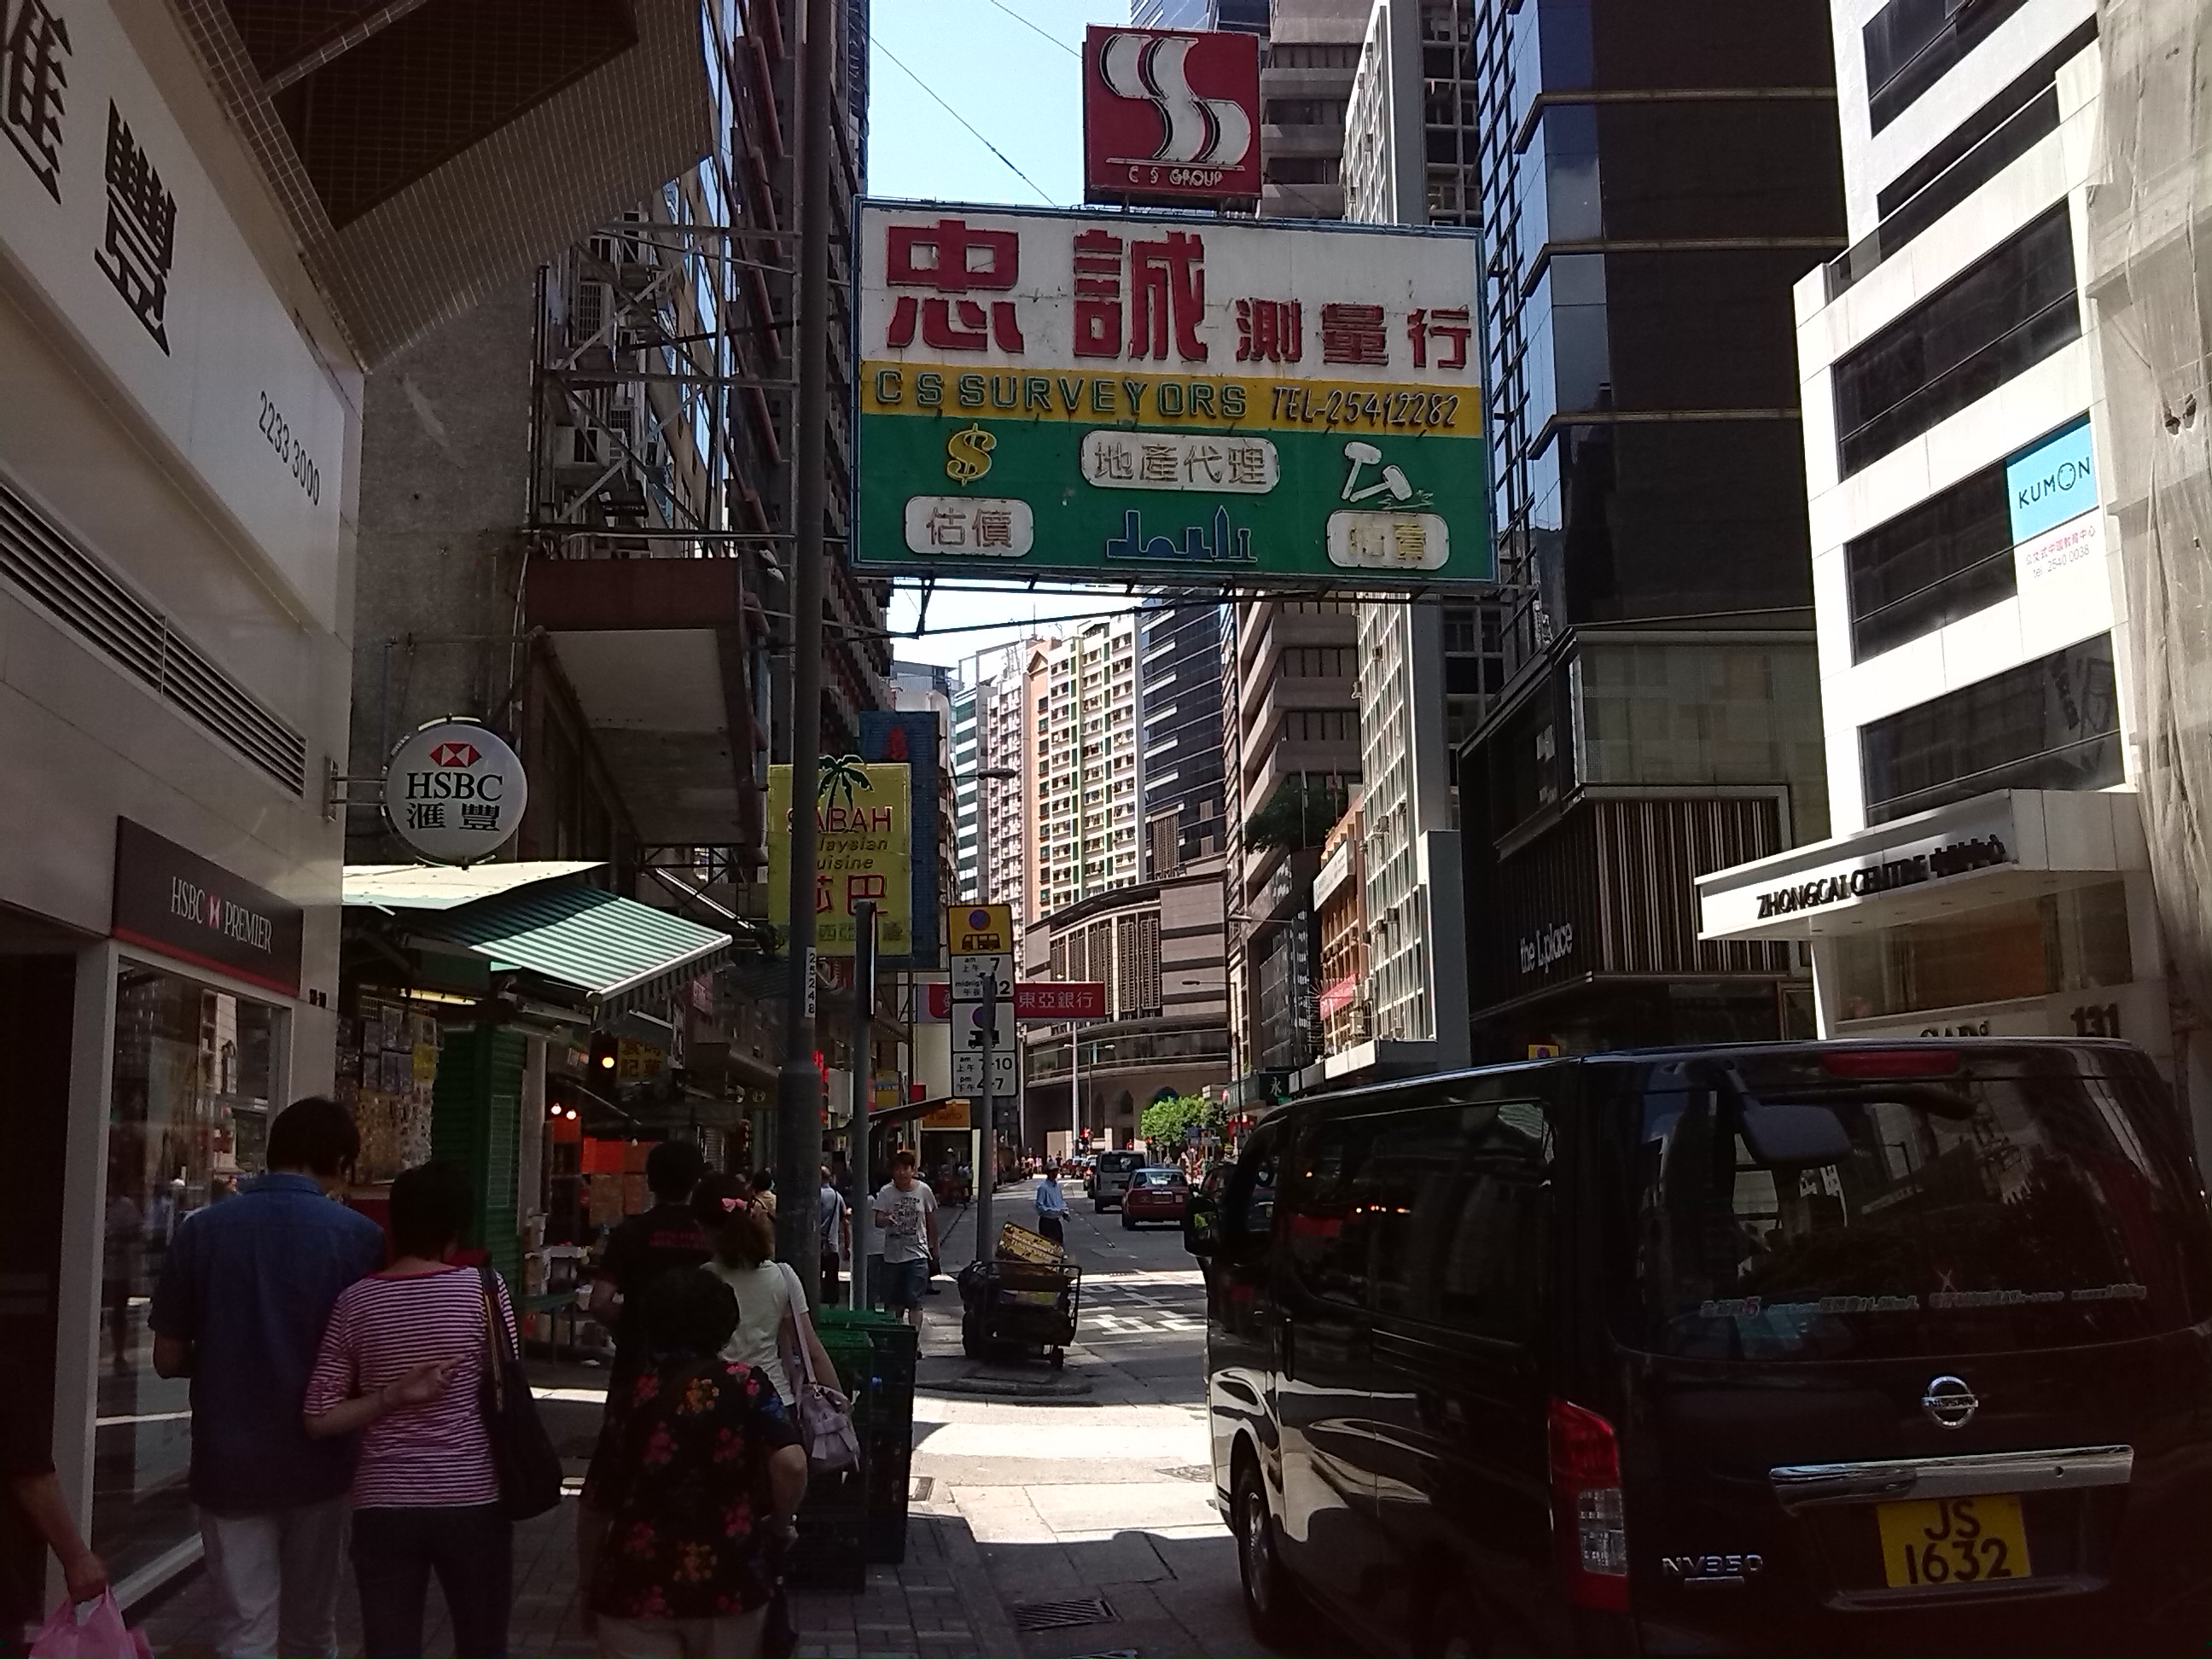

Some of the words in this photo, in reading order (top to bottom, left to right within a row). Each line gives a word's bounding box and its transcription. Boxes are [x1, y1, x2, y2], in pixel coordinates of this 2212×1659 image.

[1168, 168, 1224, 187] GROUP
[886, 219, 1472, 369] 忠誠測量行
[959, 373, 1248, 418] SURVEYORS
[259, 390, 290, 463] 2233
[293, 439, 320, 506] 3000
[1094, 443, 1267, 486] 地產代理
[2018, 457, 2091, 509] KUMON
[926, 505, 1013, 549] 估價
[2048, 556, 2068, 573] 2540
[2069, 544, 2090, 562] 0038
[405, 771, 503, 801] HSBC
[817, 857, 874, 870] uisine
[171, 876, 205, 924] HSBC
[224, 900, 273, 954] PREMIER
[990, 957, 1000, 971] 7
[1520, 937, 1535, 974] the
[807, 952, 816, 1014] 25248
[1018, 991, 1093, 1009] 東亞銀行
[1924, 1499, 1982, 1542] JS
[1660, 1552, 1764, 1575] NV350
[1903, 1537, 2011, 1585] 1632
